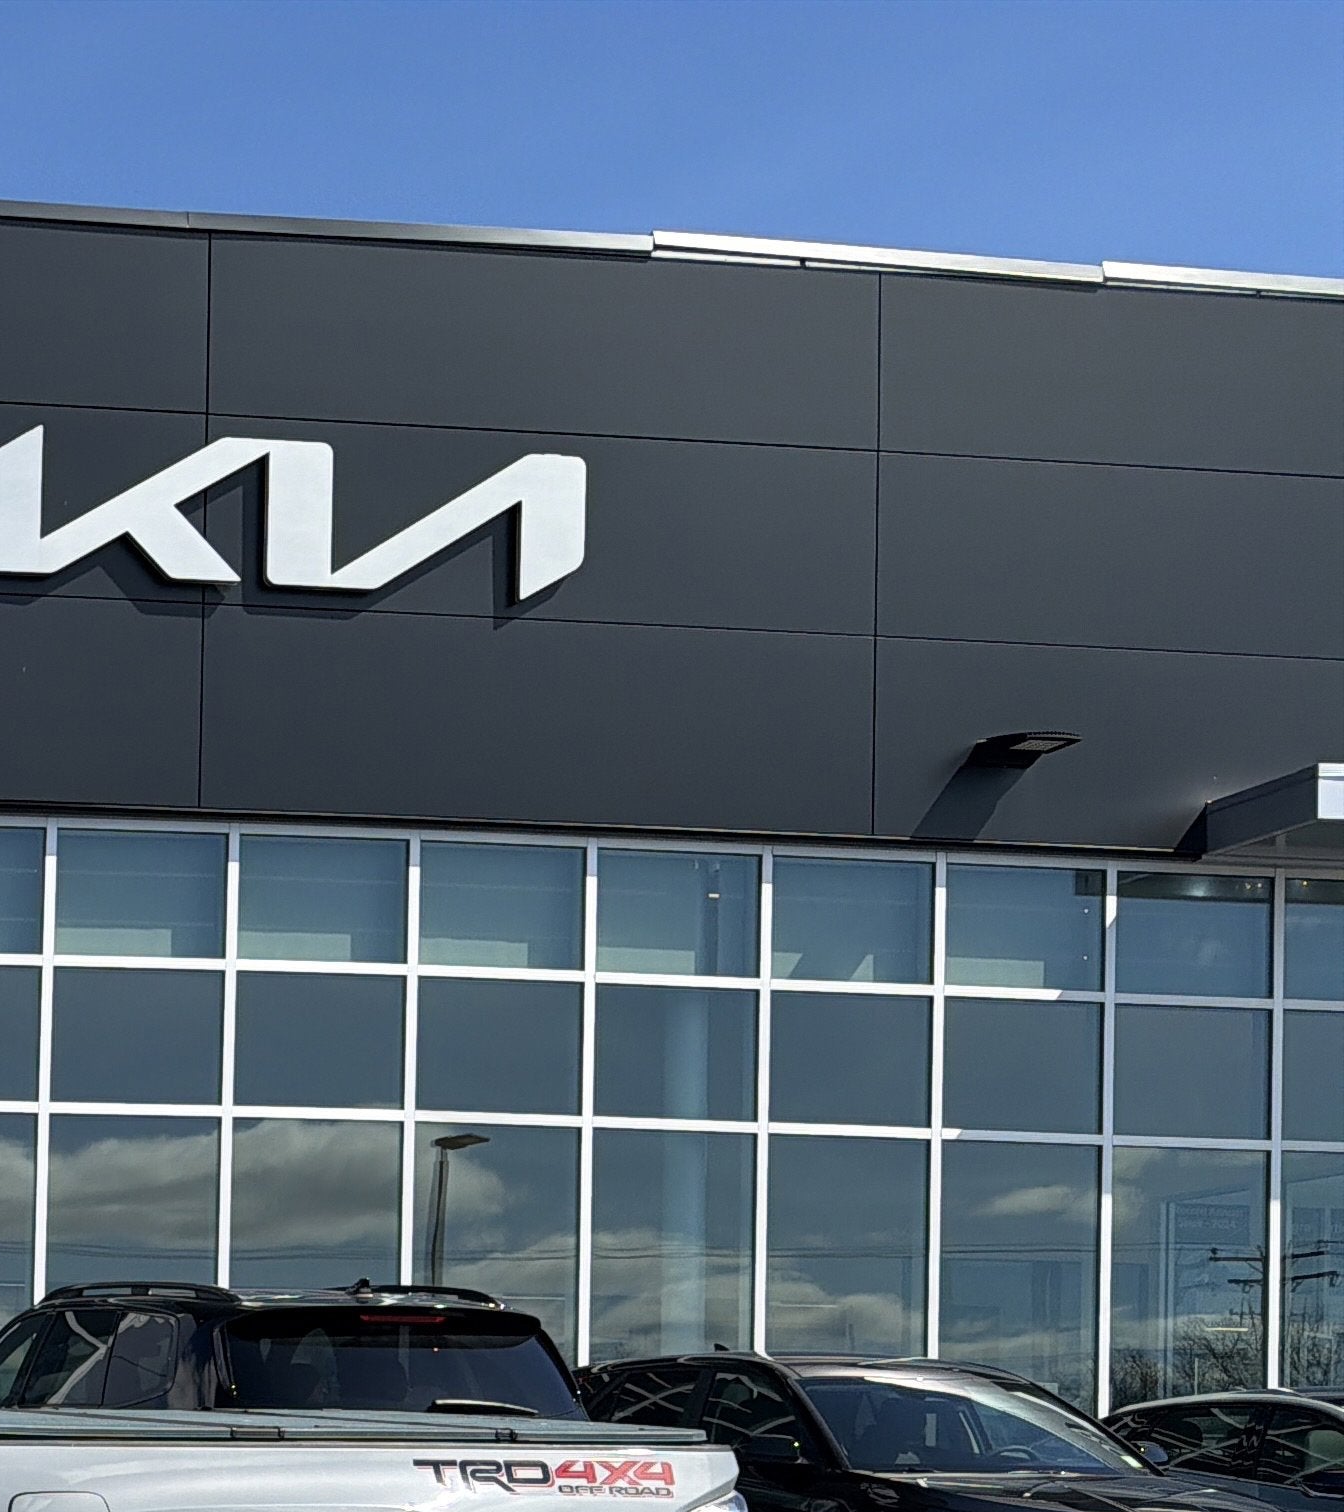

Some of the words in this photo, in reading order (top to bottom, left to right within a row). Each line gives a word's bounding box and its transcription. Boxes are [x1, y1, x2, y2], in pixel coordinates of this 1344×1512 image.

[413, 1459, 555, 1495] TRD
[558, 1484, 605, 1496] OFF
[608, 1486, 674, 1498] ROAD
